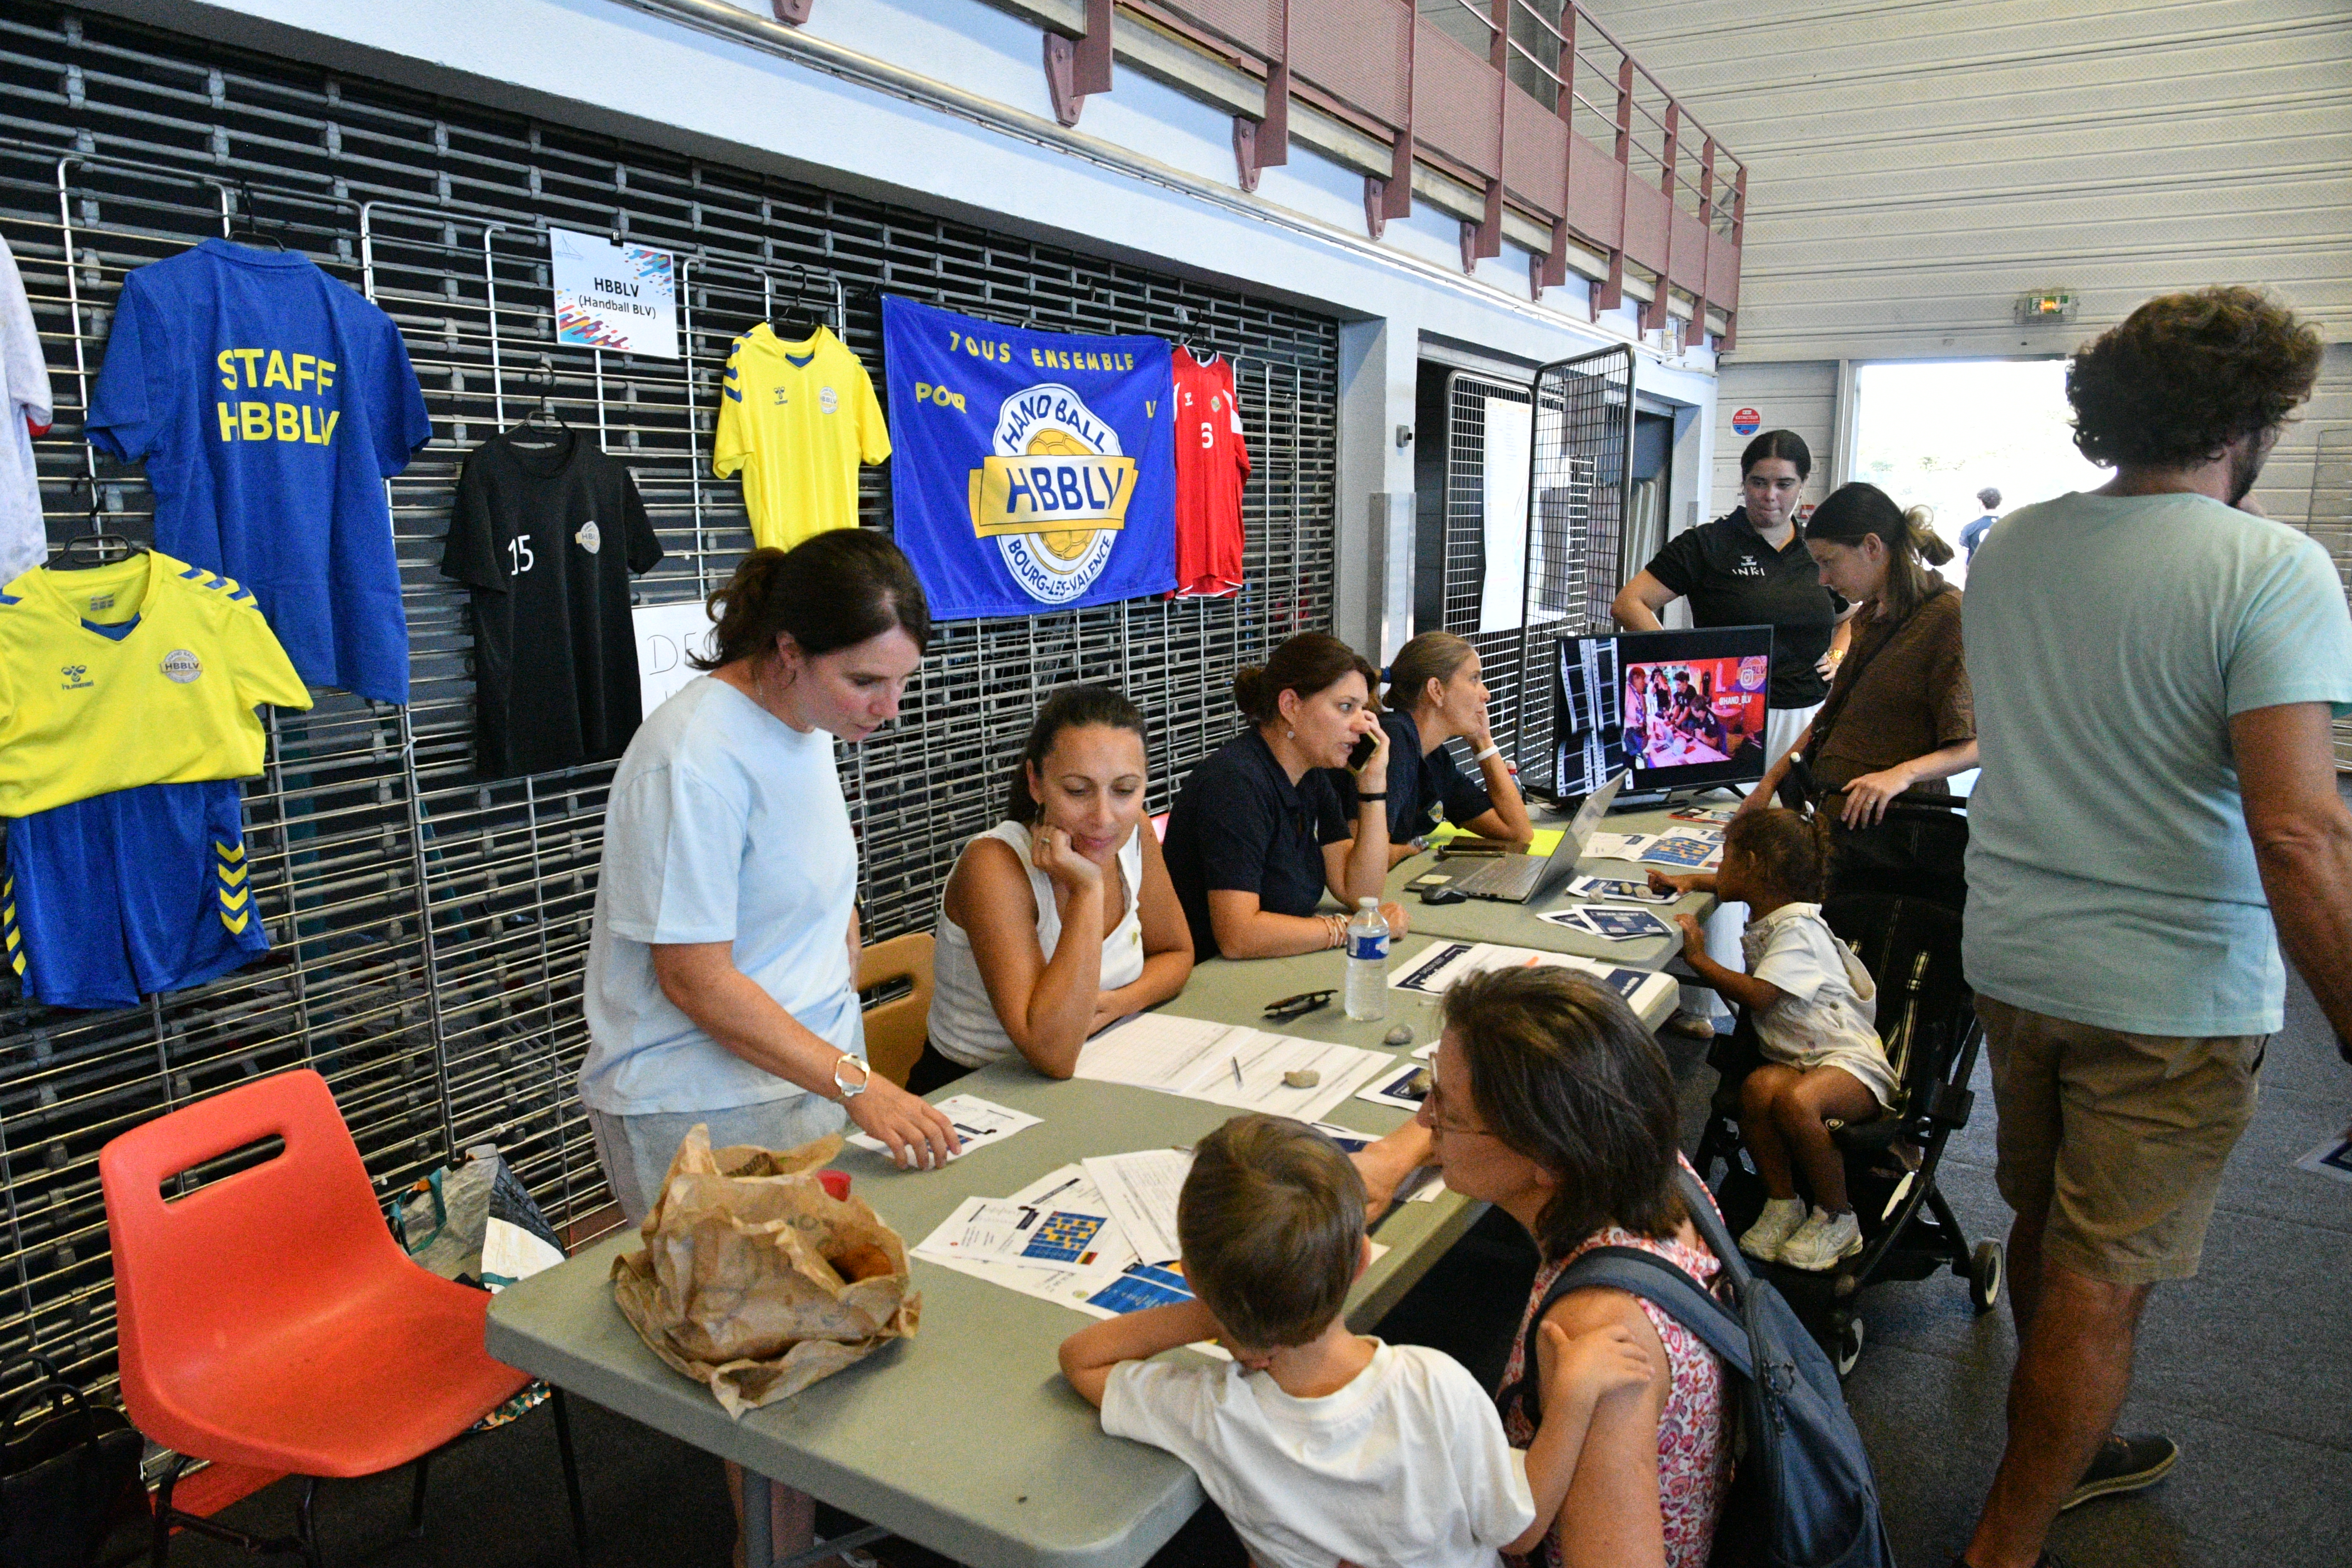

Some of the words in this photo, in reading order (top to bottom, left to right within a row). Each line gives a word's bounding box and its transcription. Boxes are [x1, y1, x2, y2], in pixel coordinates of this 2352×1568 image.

[579, 294, 629, 313] (Handball
[633, 304, 656, 320] BLV)
[594, 277, 639, 297] HBBLV
[217, 348, 337, 396] STAFF
[950, 331, 1011, 363] TOUS
[1031, 348, 1134, 371] ENSEMBLE
[217, 402, 340, 446] HBBLV
[1002, 395, 1051, 454] HAND
[1055, 397, 1105, 454] BALL
[1005, 466, 1124, 513] HBBLV
[508, 534, 534, 576] 15
[1007, 535, 1111, 596] BOURG-LES-VALENCE
[165, 662, 200, 670] HBBLV
